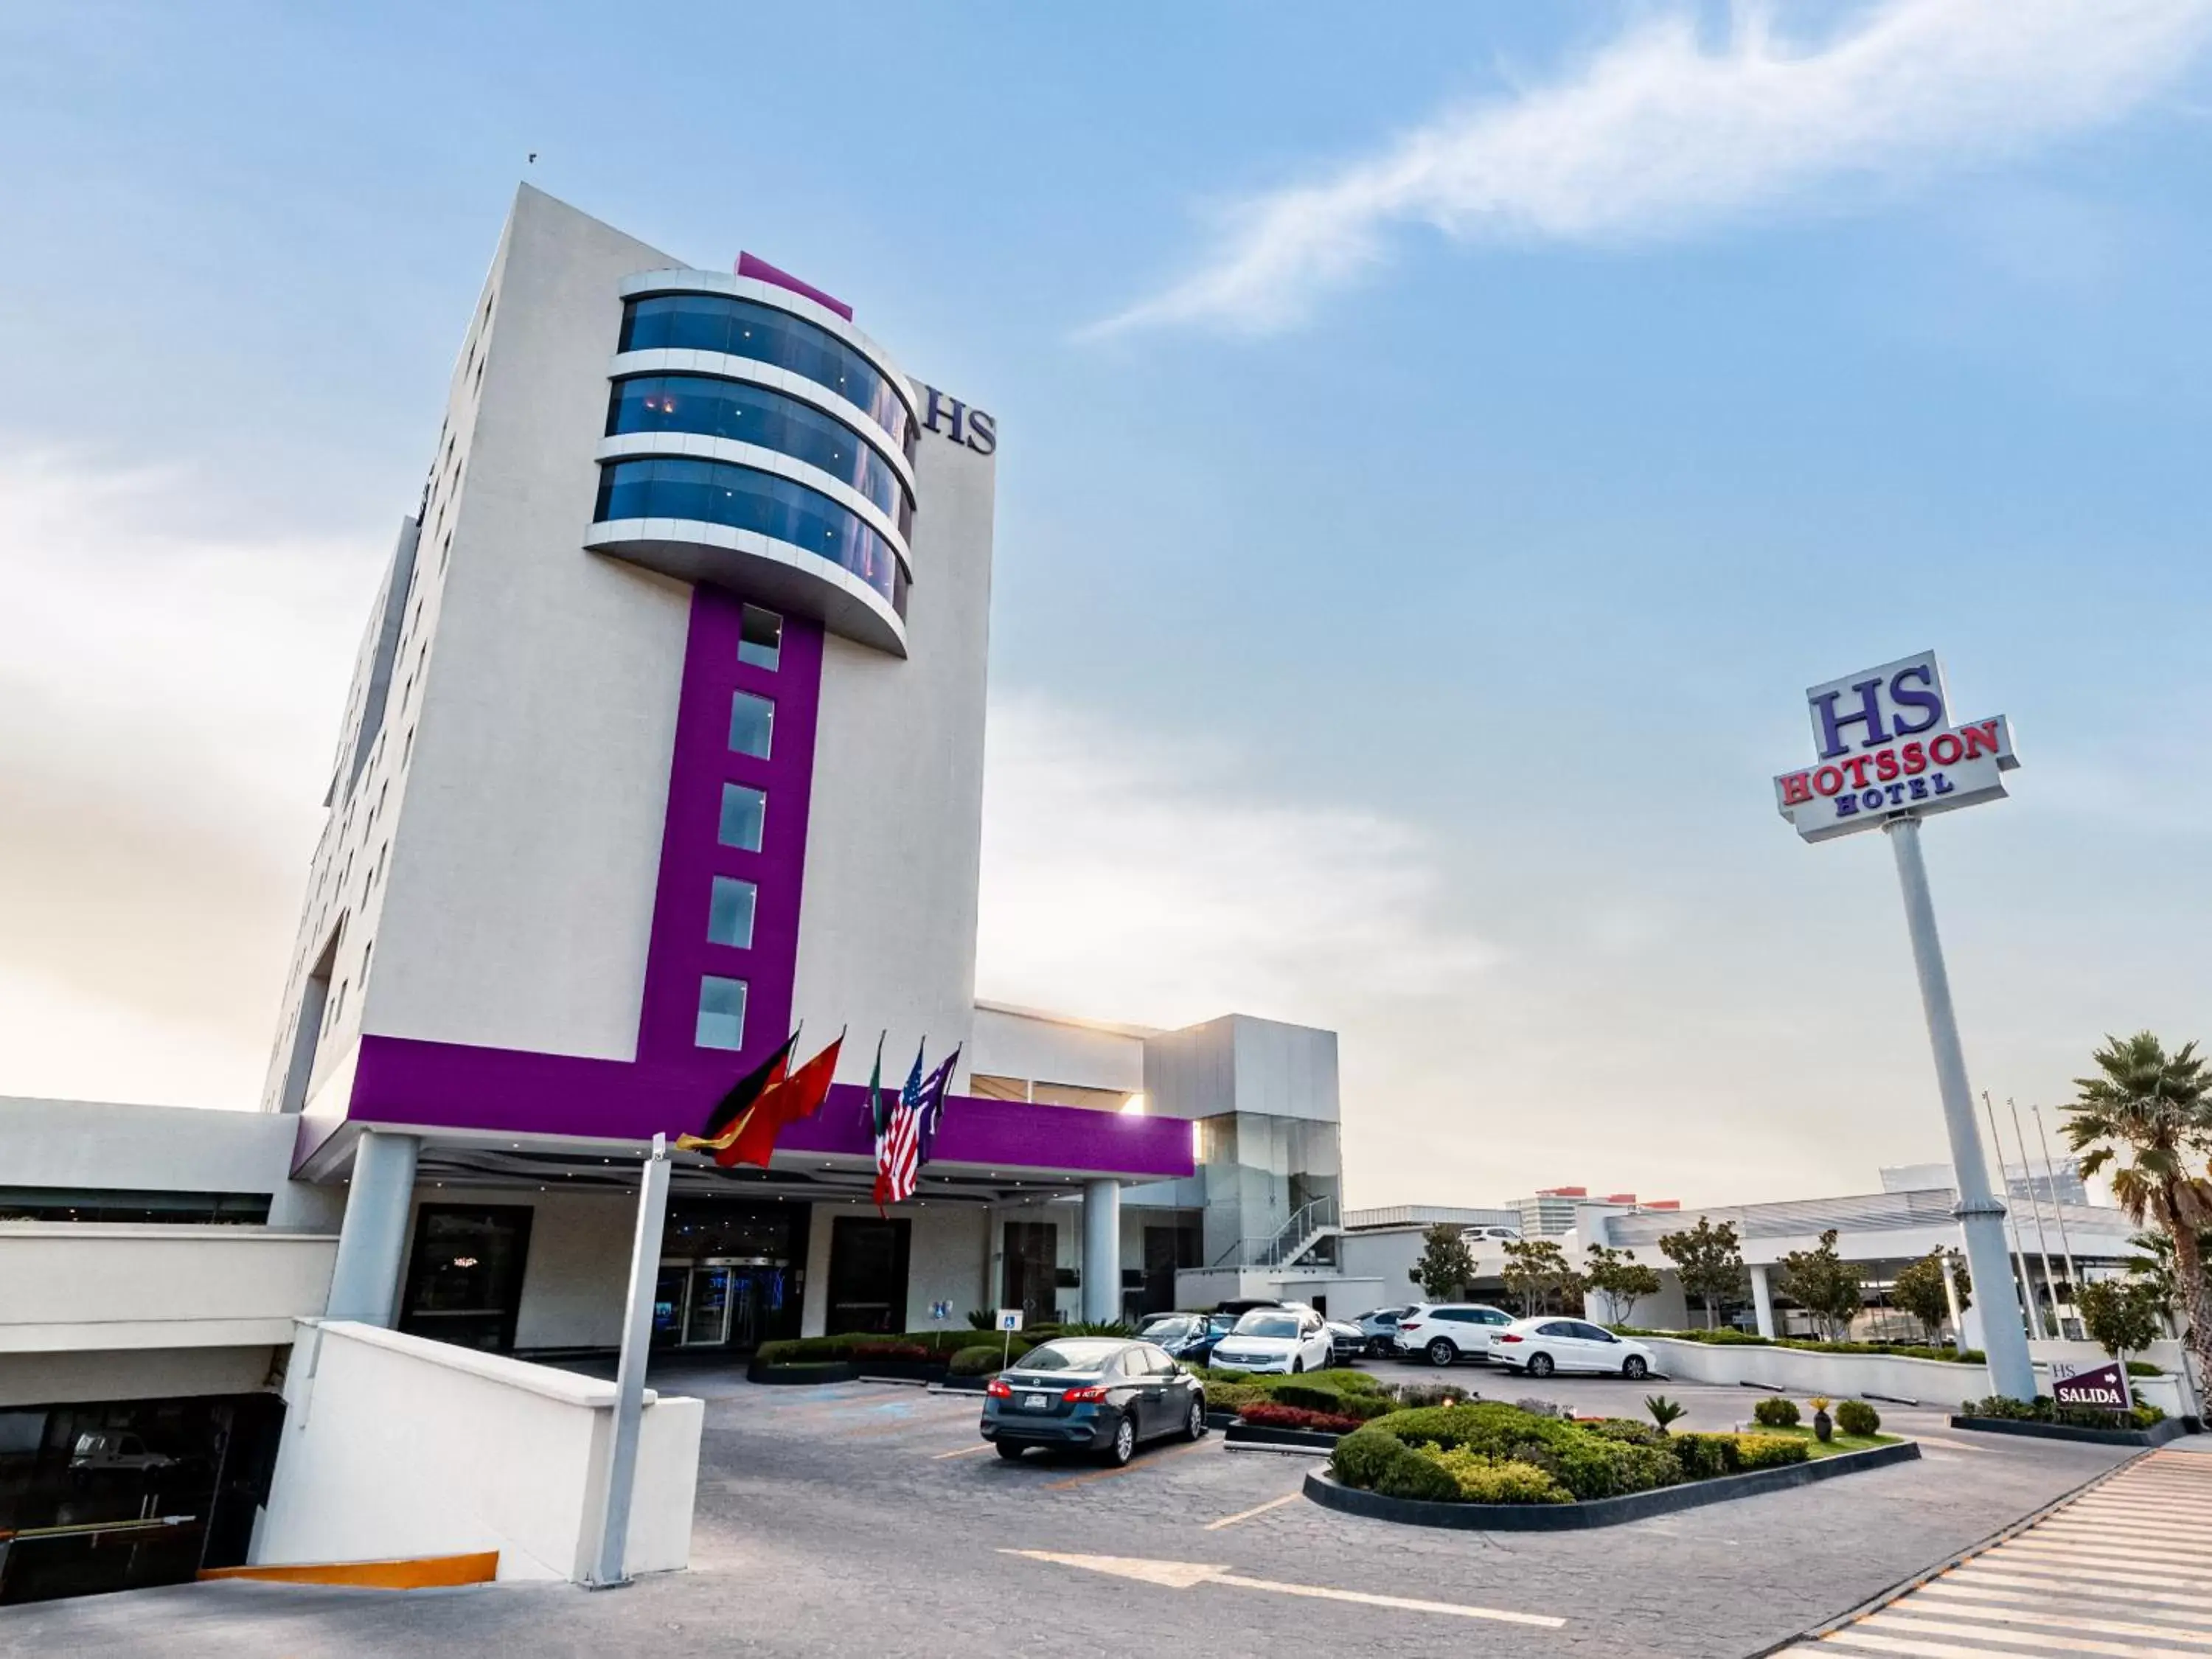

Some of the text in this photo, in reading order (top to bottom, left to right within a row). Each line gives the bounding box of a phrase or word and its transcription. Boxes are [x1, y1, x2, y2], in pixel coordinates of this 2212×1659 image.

[922, 385, 997, 455] HS
[1809, 664, 1942, 759] HS
[1780, 720, 2000, 806] HOTSSON
[1834, 773, 1955, 818] HOTEL
[2053, 1364, 2076, 1378] HS
[2059, 1387, 2122, 1403] SALIDA
